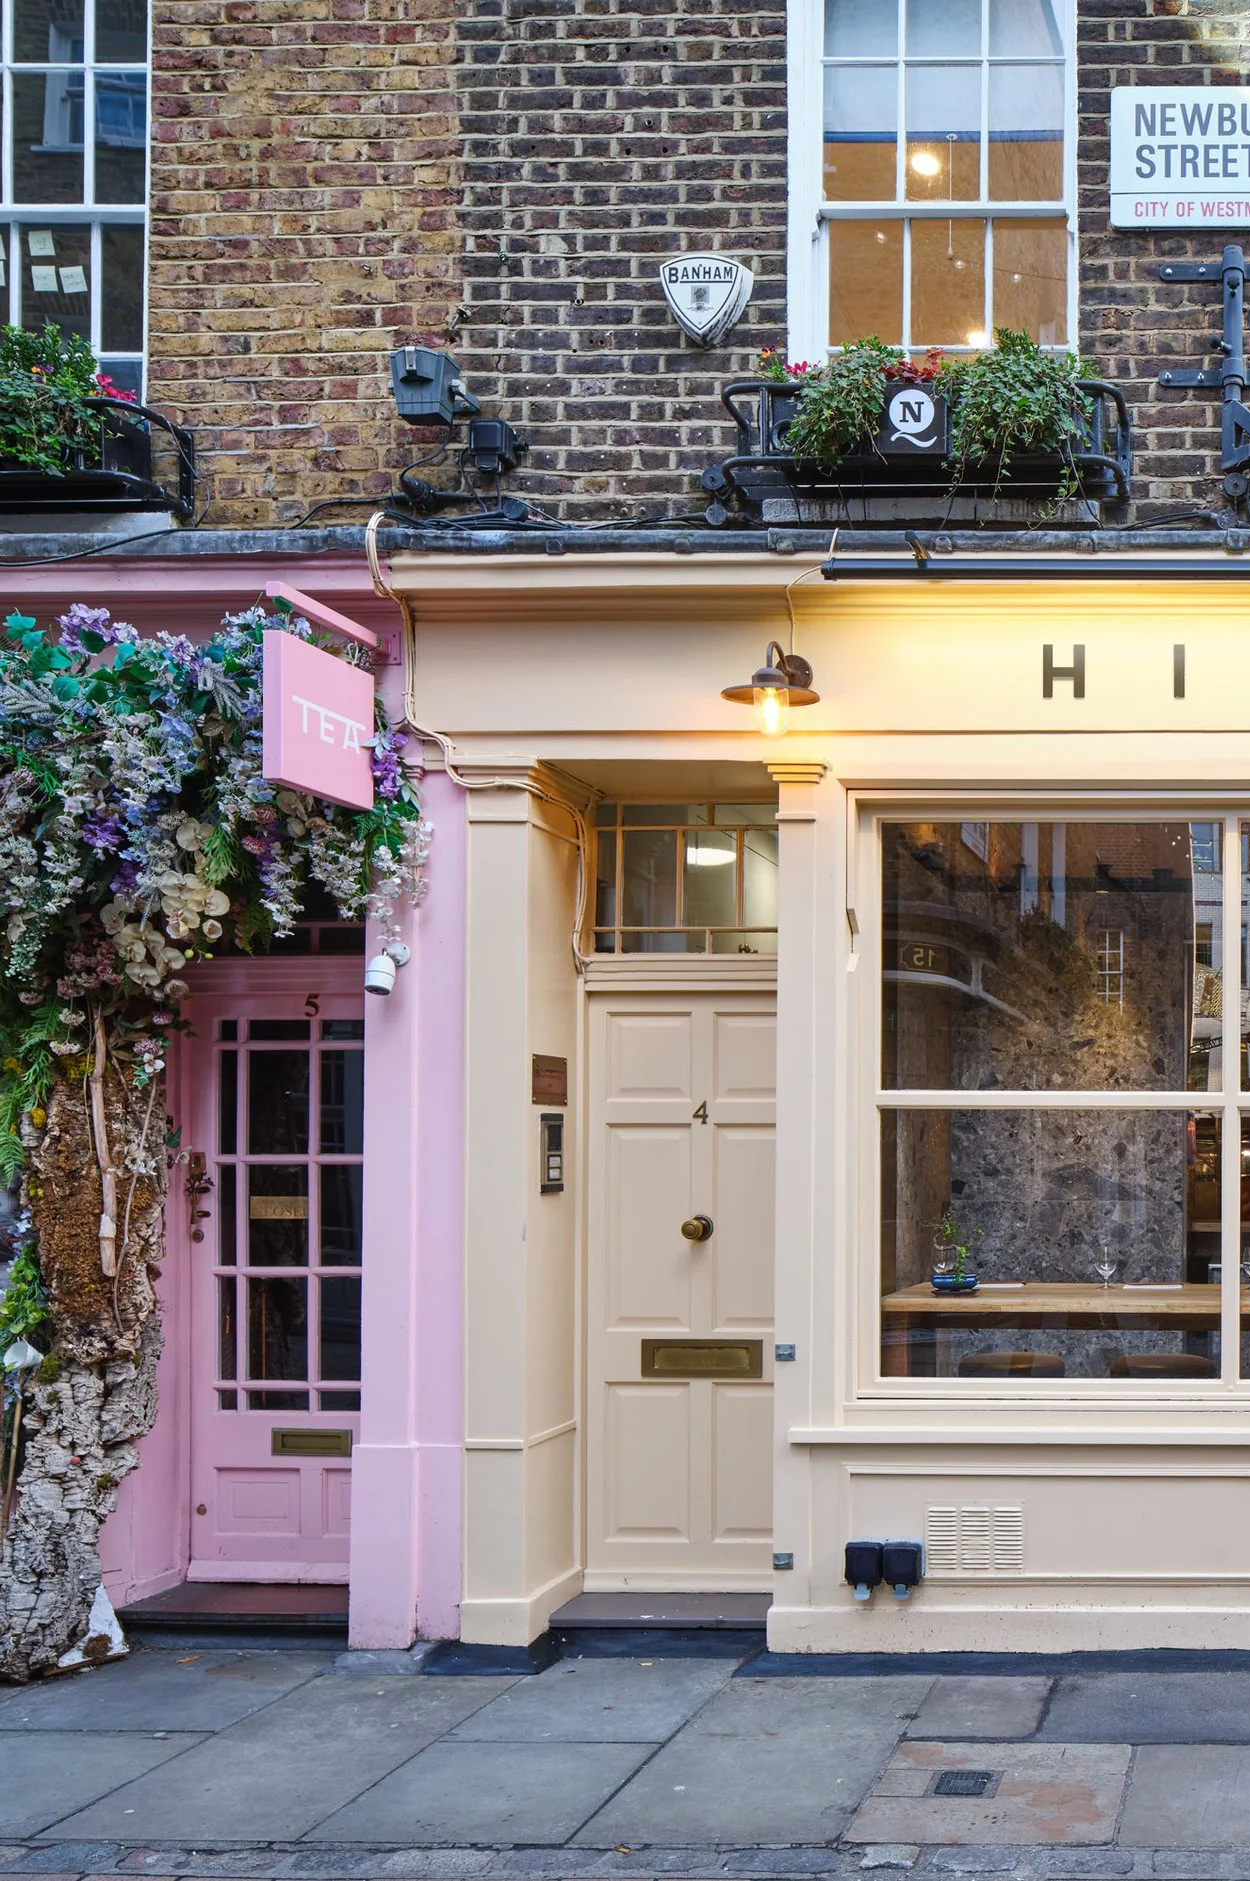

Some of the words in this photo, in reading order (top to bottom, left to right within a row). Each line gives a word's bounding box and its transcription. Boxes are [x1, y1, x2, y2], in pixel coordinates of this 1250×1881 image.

[1134, 201, 1169, 218] CITY
[1175, 201, 1195, 218] OF
[668, 266, 733, 284] BANHAM
[292, 694, 367, 754] TEA
[304, 993, 320, 1018] 5
[692, 1100, 709, 1125] 4
